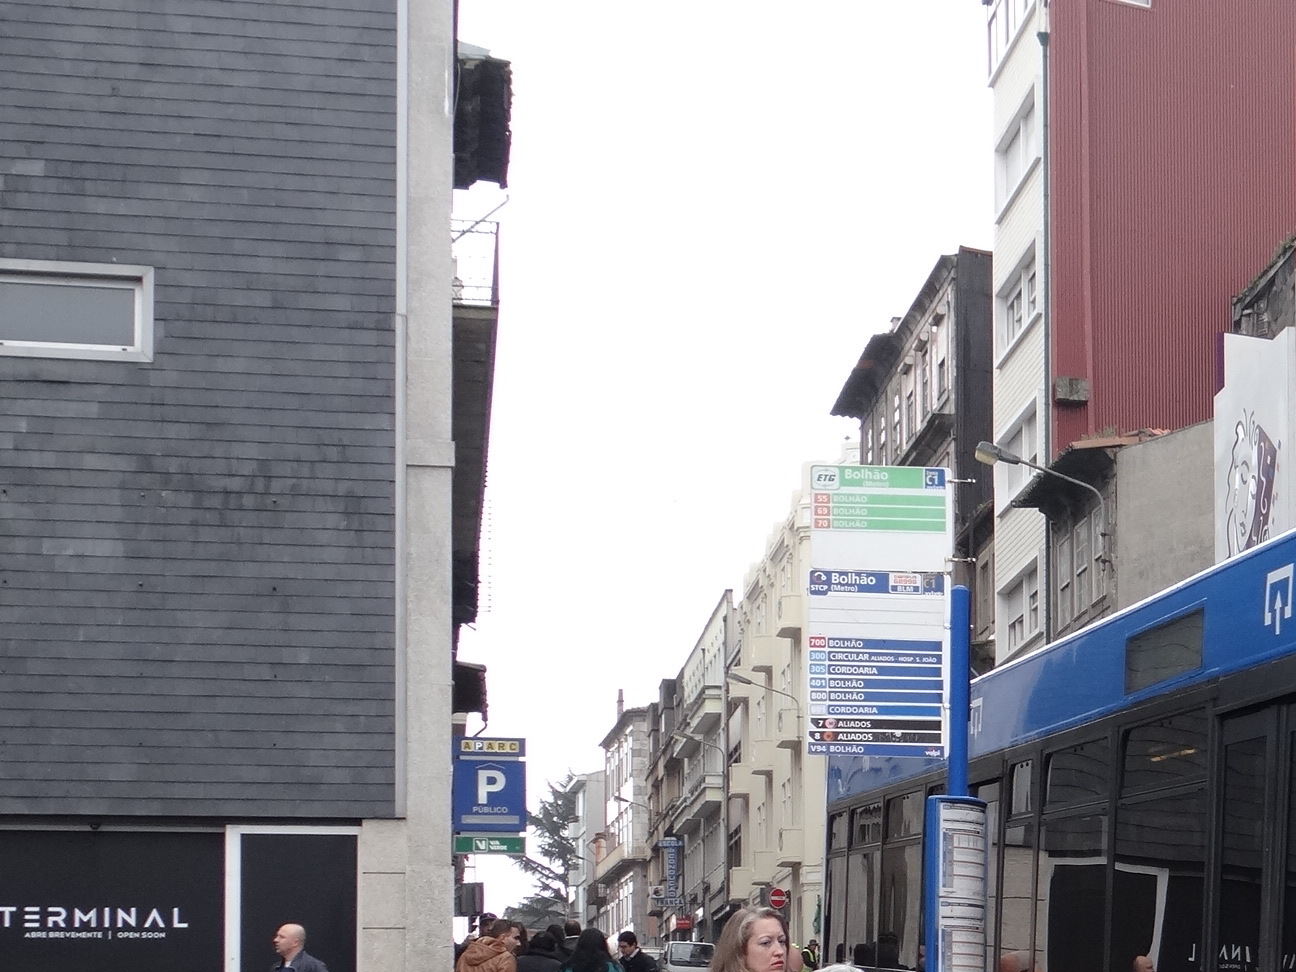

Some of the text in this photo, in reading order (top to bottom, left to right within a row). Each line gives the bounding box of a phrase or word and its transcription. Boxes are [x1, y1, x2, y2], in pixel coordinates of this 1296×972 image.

[816, 473, 837, 482] ETG
[844, 468, 889, 480] Bolhão
[926, 475, 939, 485] C1
[833, 494, 868, 503] BOLHÃO
[817, 506, 868, 515] 69 BOLHÃO
[833, 519, 868, 528] BOLHÃO
[831, 573, 876, 585] Bolhão
[831, 585, 858, 593] (Metro)
[829, 639, 863, 648] BOLHÃO
[811, 652, 826, 660] 300
[830, 653, 869, 661] CIRCULAR
[811, 665, 878, 674] 305 CORDOARIA
[829, 679, 864, 688] BOLHÃO
[830, 692, 864, 700] BOLHÃO
[829, 706, 878, 714] CORDOARIA
[463, 741, 518, 752] APARC
[829, 744, 864, 753] BOLHÃO
[477, 769, 507, 805] P
[0, 906, 189, 928] TERMINAL
[24, 931, 103, 939] ABRE BREVEMENTE
[117, 931, 166, 939] OPEN SOON
